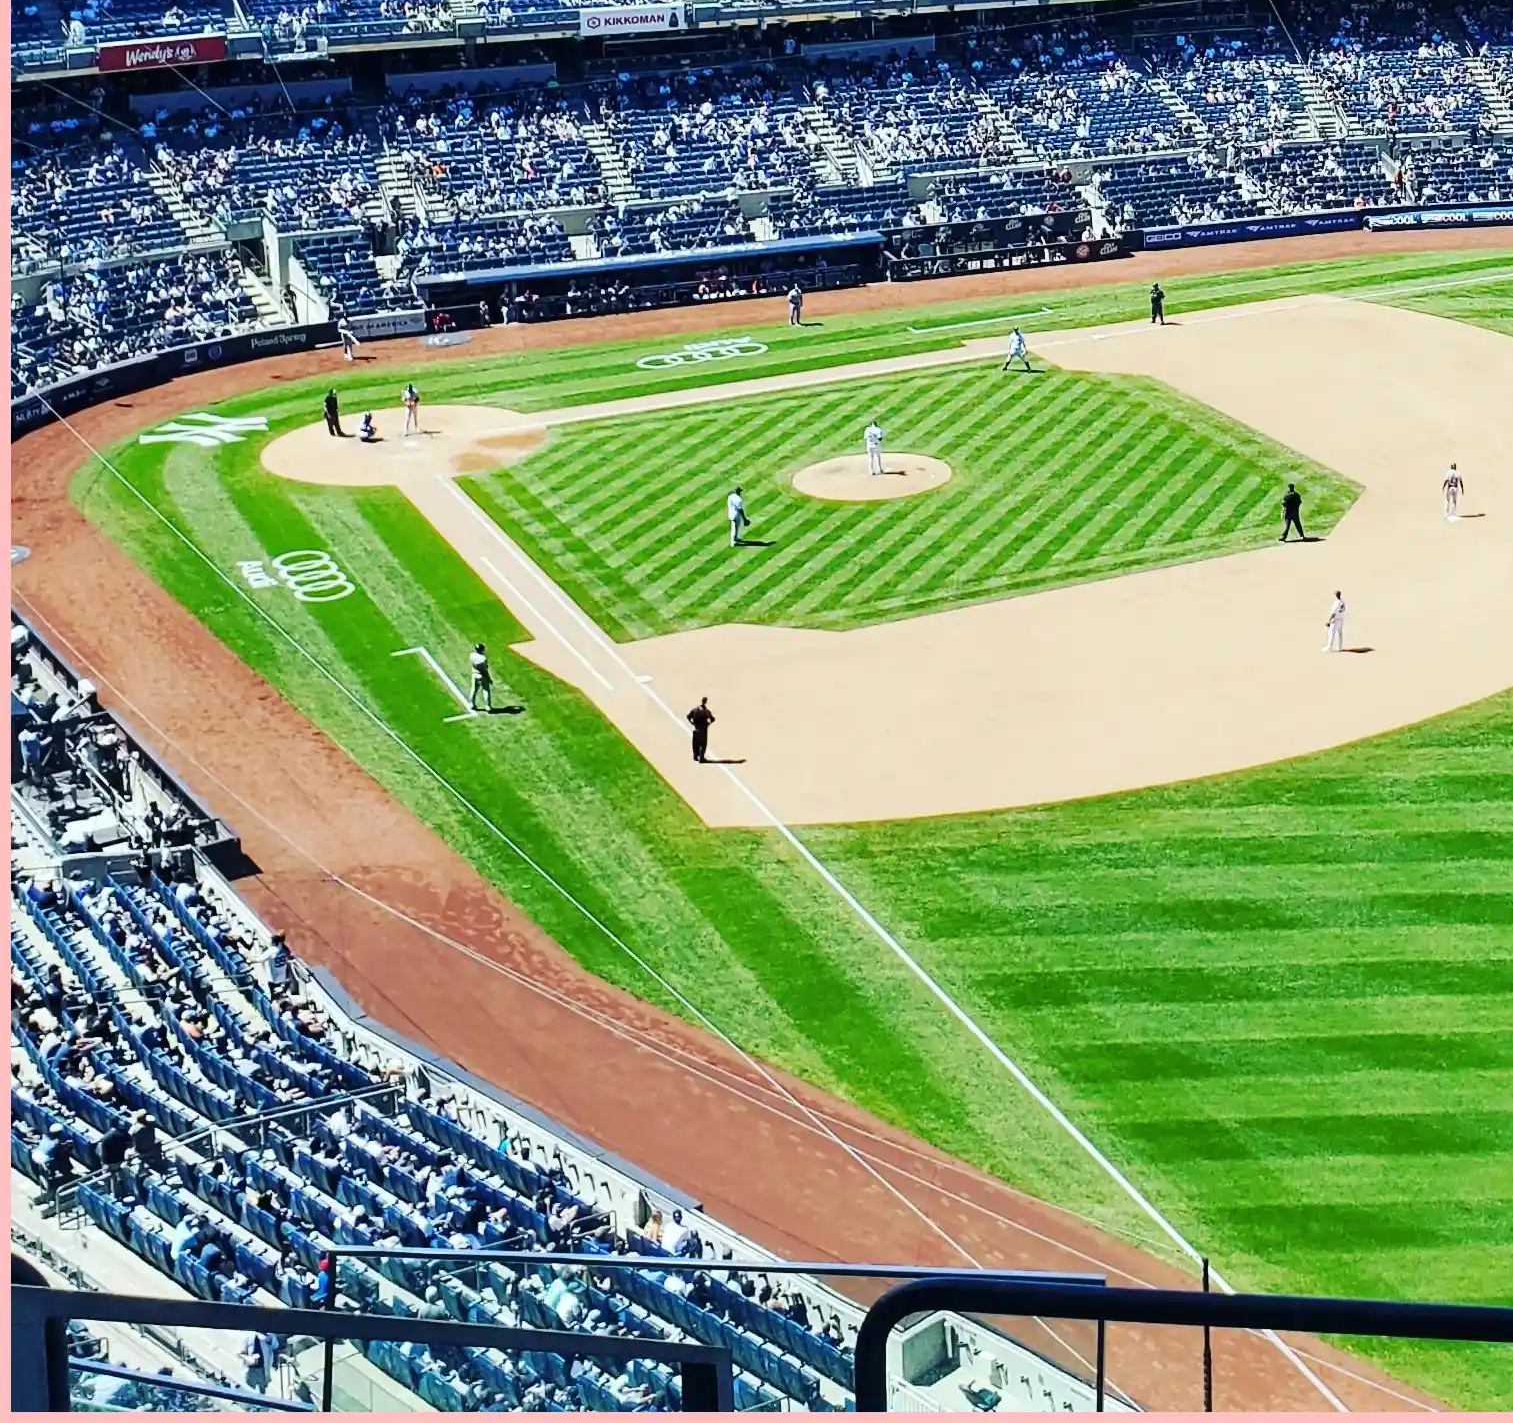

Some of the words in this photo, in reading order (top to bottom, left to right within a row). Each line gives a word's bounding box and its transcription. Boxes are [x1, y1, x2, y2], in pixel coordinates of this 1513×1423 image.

[604, 14, 665, 26] KIKKOMAN
[125, 44, 174, 66] Wendy's
[1146, 233, 1182, 243] GEICO
[1199, 229, 1237, 237] AMTRAK
